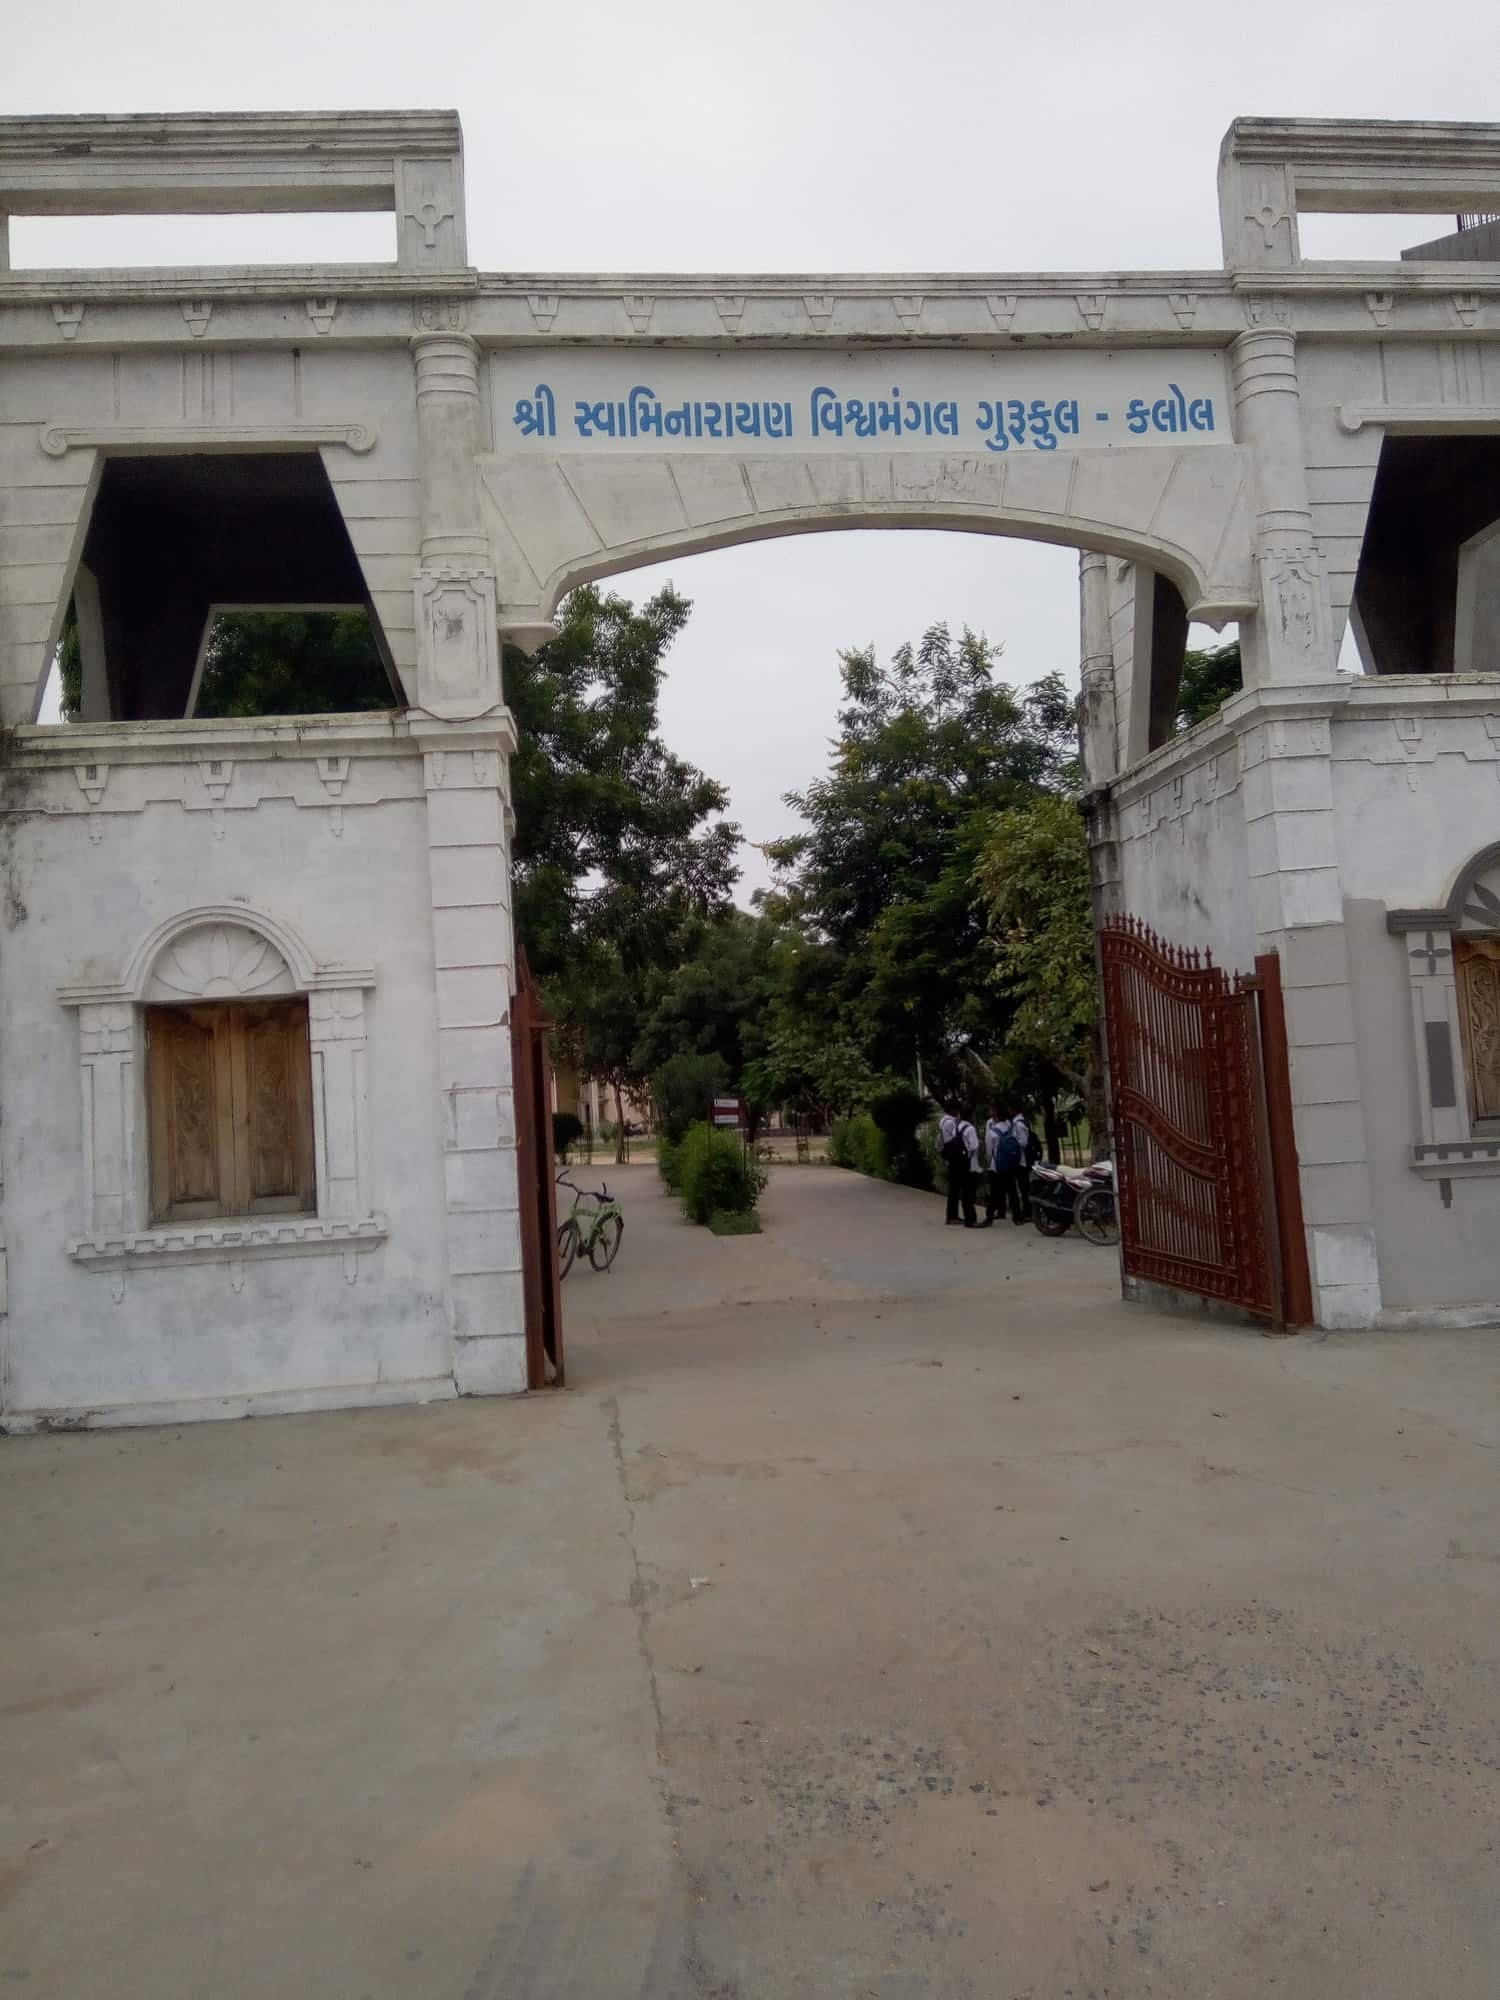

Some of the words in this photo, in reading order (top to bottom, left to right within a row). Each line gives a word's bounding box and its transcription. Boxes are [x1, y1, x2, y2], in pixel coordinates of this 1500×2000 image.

[512, 384, 556, 437] શ્રી
[575, 386, 793, 438] સ્વામિનારાયણ
[810, 386, 960, 438] વિશ્વમંગલ
[1095, 412, 1109, 422] -
[1125, 383, 1216, 435] કલોલ
